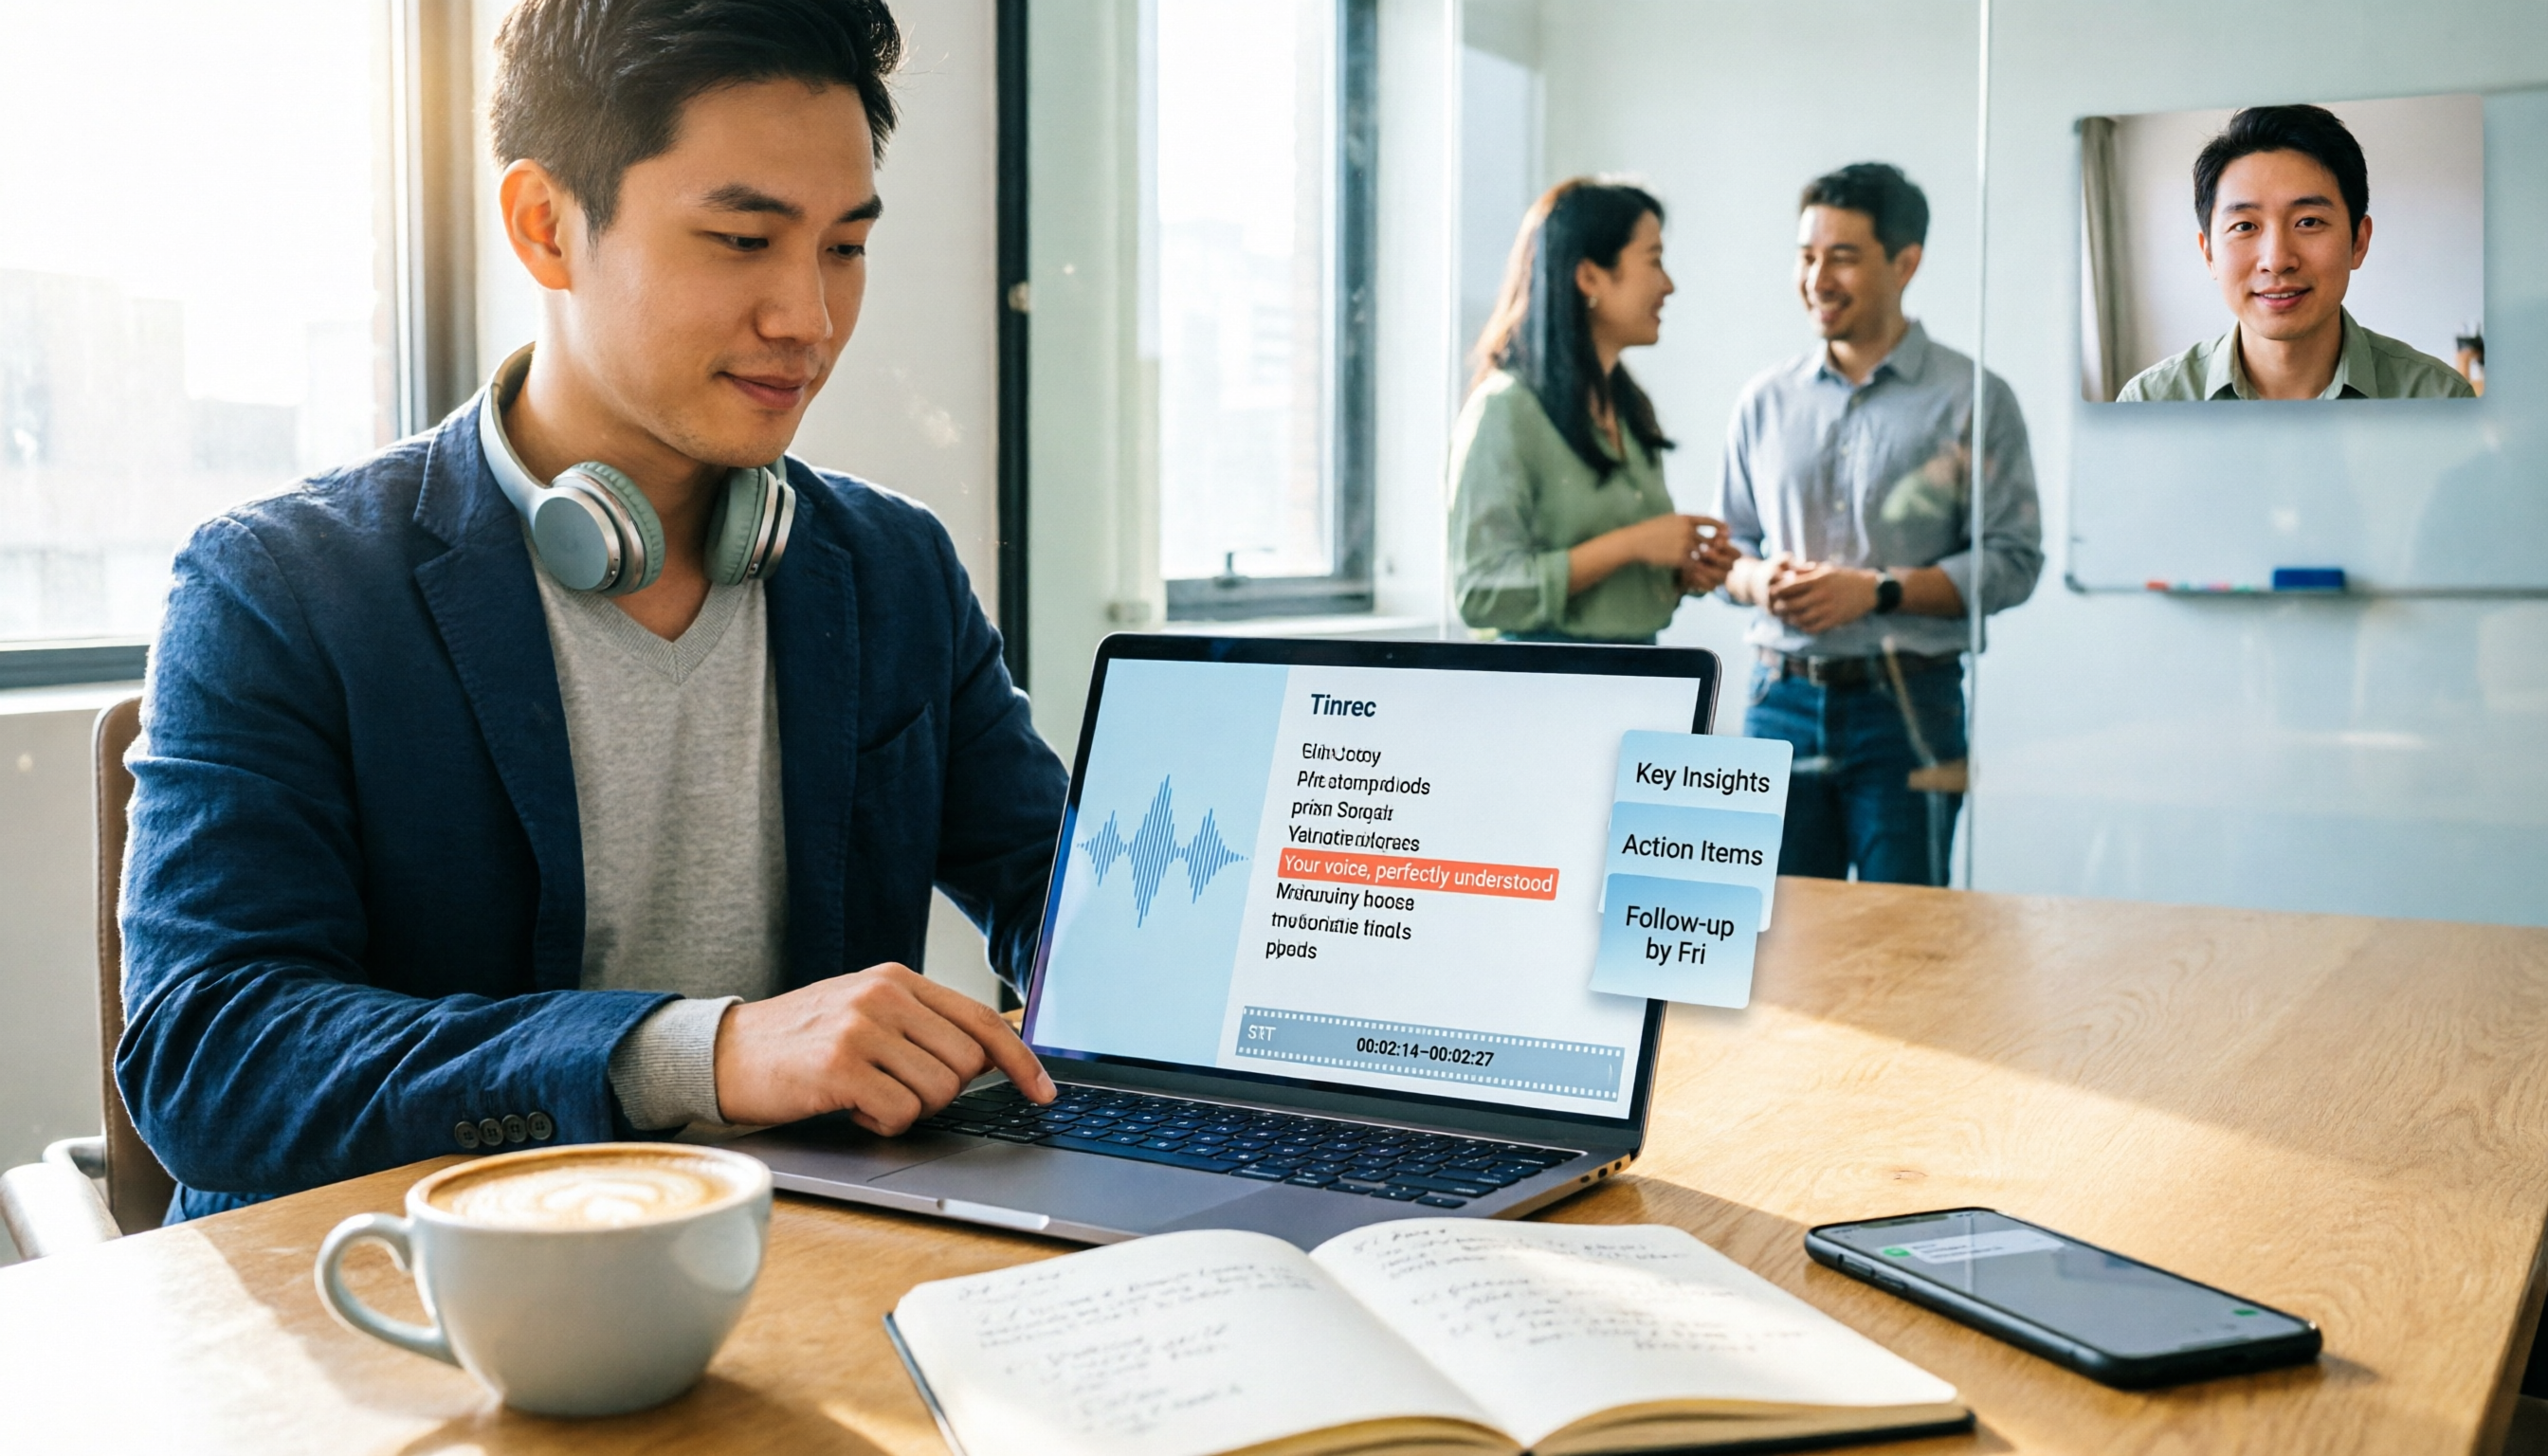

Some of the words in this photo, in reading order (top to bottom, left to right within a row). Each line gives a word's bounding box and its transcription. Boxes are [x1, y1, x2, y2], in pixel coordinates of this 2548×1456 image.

[1311, 693, 1376, 718] Tinrec
[1636, 762, 1676, 791] Key
[1683, 766, 1771, 796] Insights
[1622, 834, 1694, 860] Action
[1701, 840, 1764, 866] Items
[1284, 855, 1321, 873] Your
[1324, 861, 1372, 880] voice,
[1374, 864, 1450, 889] perfectly
[1454, 870, 1554, 892] understood
[1626, 905, 1735, 941] Follow-up
[1646, 937, 1672, 966] by
[1678, 941, 1706, 965] Fri
